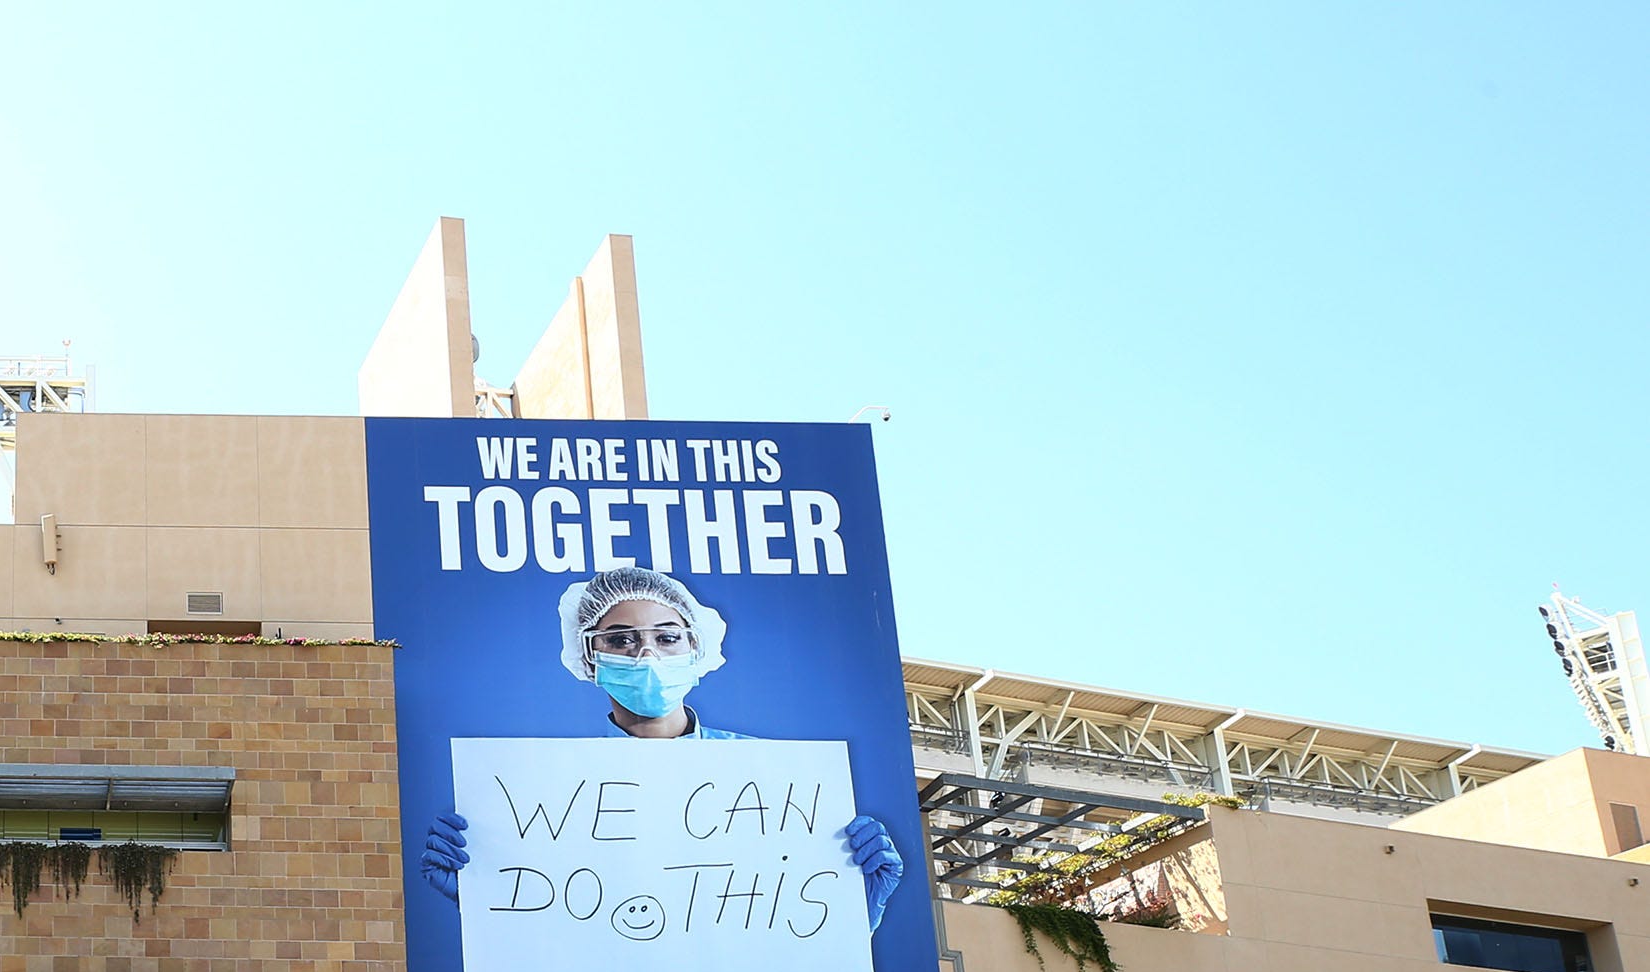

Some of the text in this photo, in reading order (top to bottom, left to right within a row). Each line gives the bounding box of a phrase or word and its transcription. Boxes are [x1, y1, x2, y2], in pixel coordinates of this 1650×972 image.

[476, 436, 782, 484] WE ARE IN THIS
[423, 484, 848, 576] TOGETHER
[495, 775, 821, 841] WE CAN
[490, 867, 603, 921] DO
